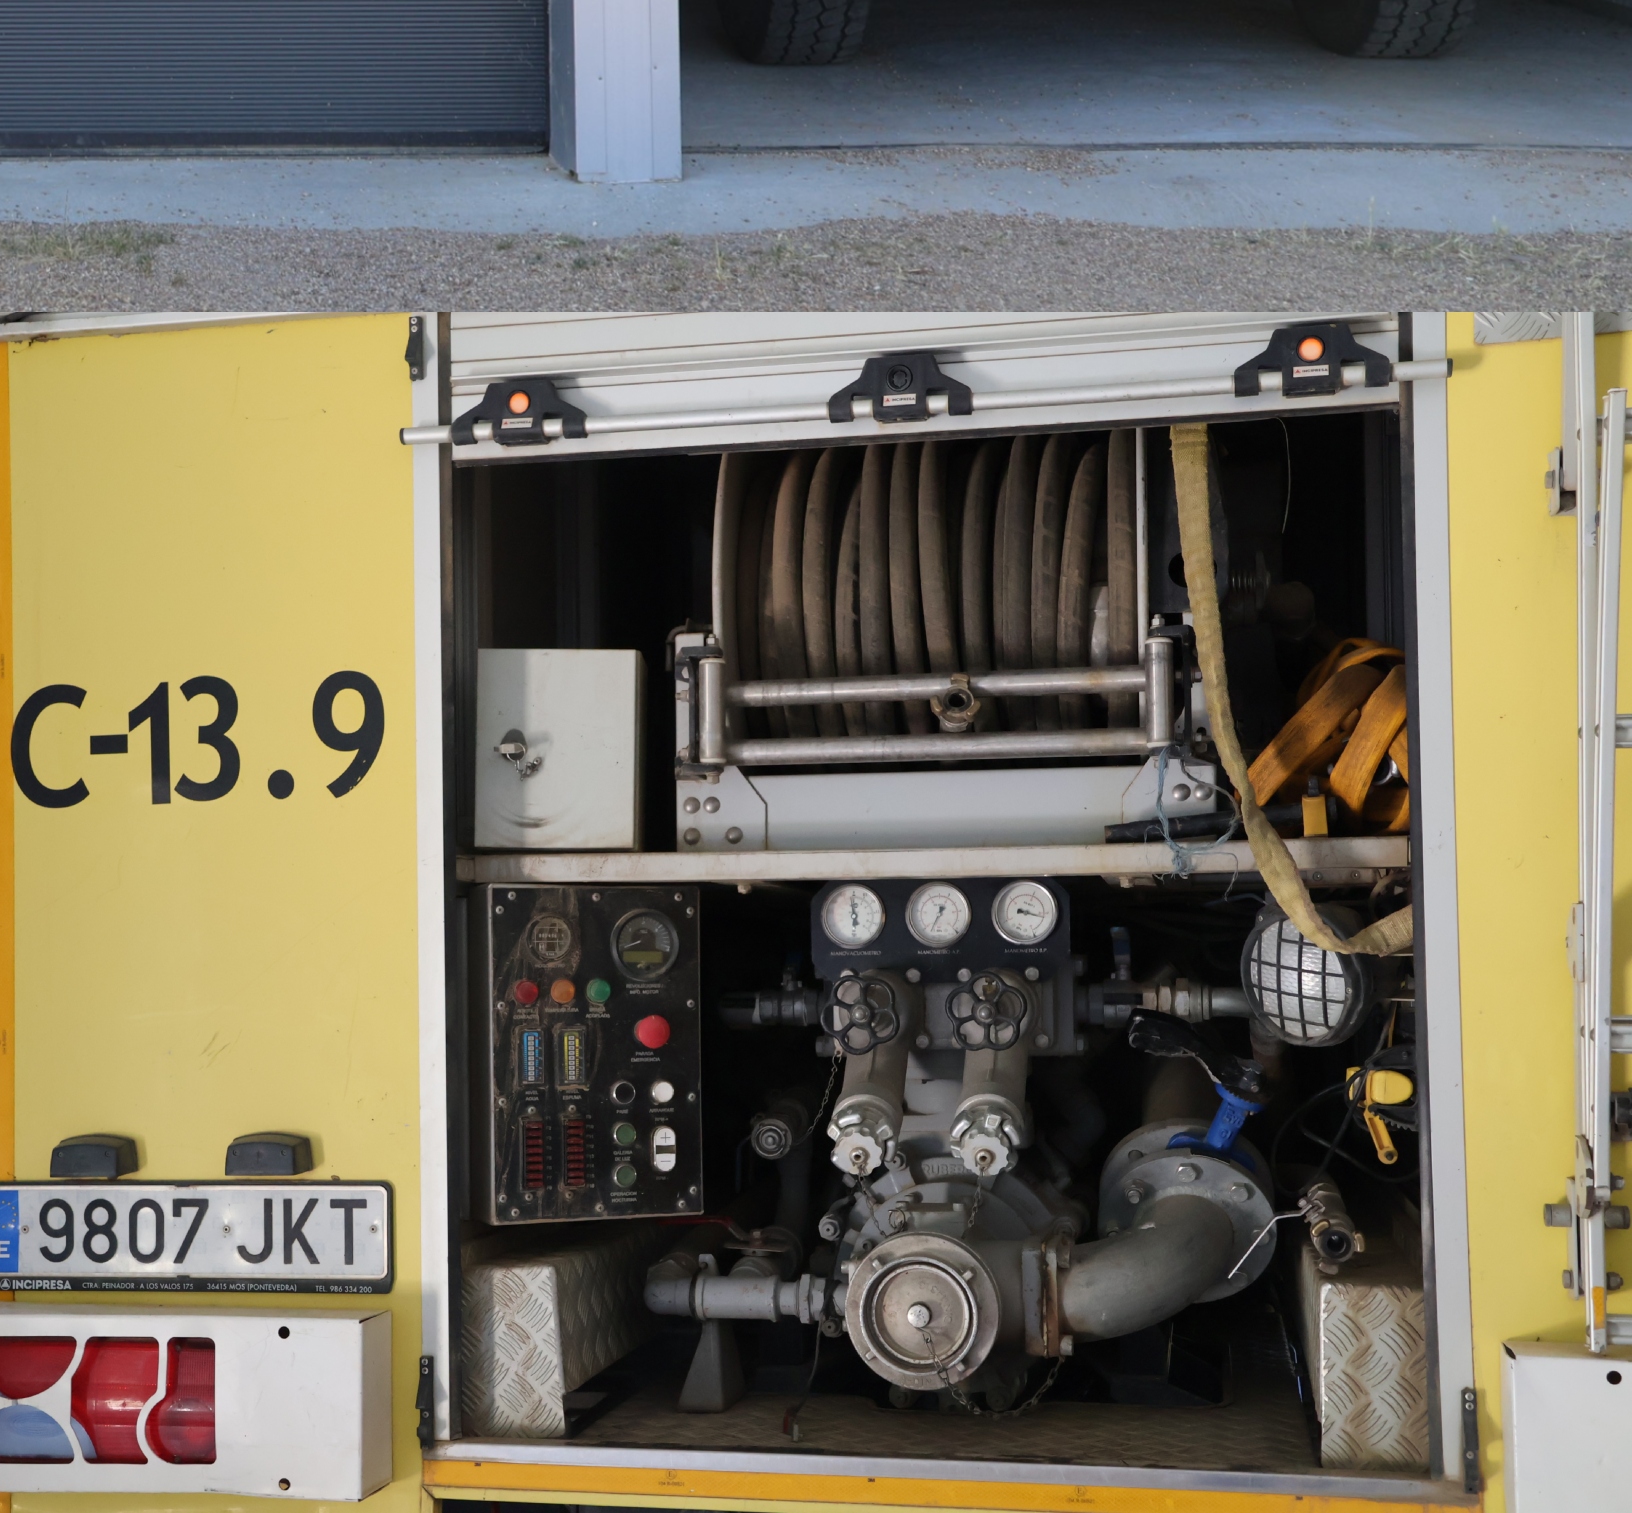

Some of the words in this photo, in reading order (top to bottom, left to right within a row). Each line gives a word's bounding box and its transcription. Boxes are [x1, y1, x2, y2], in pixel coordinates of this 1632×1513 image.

[11, 669, 385, 808] C-13.9
[39, 1197, 209, 1265] 9807
[236, 1198, 368, 1266] JKT
[12, 1279, 72, 1290] INCIPRESA
[247, 1283, 297, 1292] (PONTEVEDRA)
